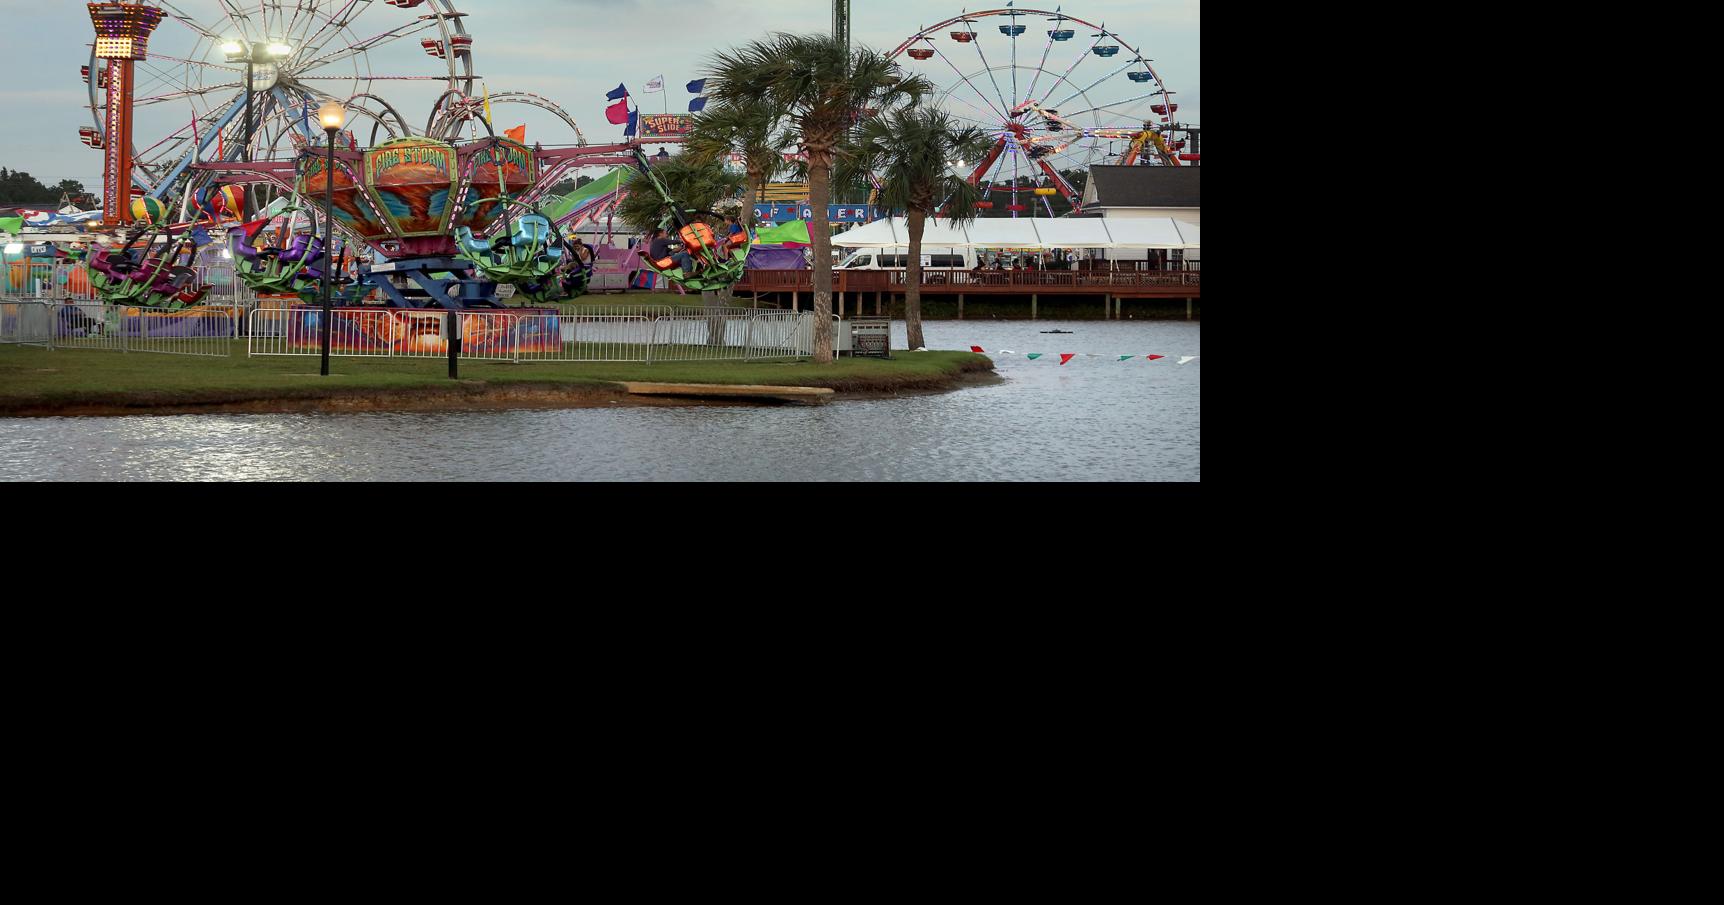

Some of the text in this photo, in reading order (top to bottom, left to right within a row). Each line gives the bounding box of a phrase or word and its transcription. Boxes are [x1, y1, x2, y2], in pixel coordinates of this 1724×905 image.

[649, 116, 679, 128] SUPER
[658, 124, 679, 133] SLIDE
[376, 148, 400, 178] FIRE
[404, 147, 447, 177] STORM
